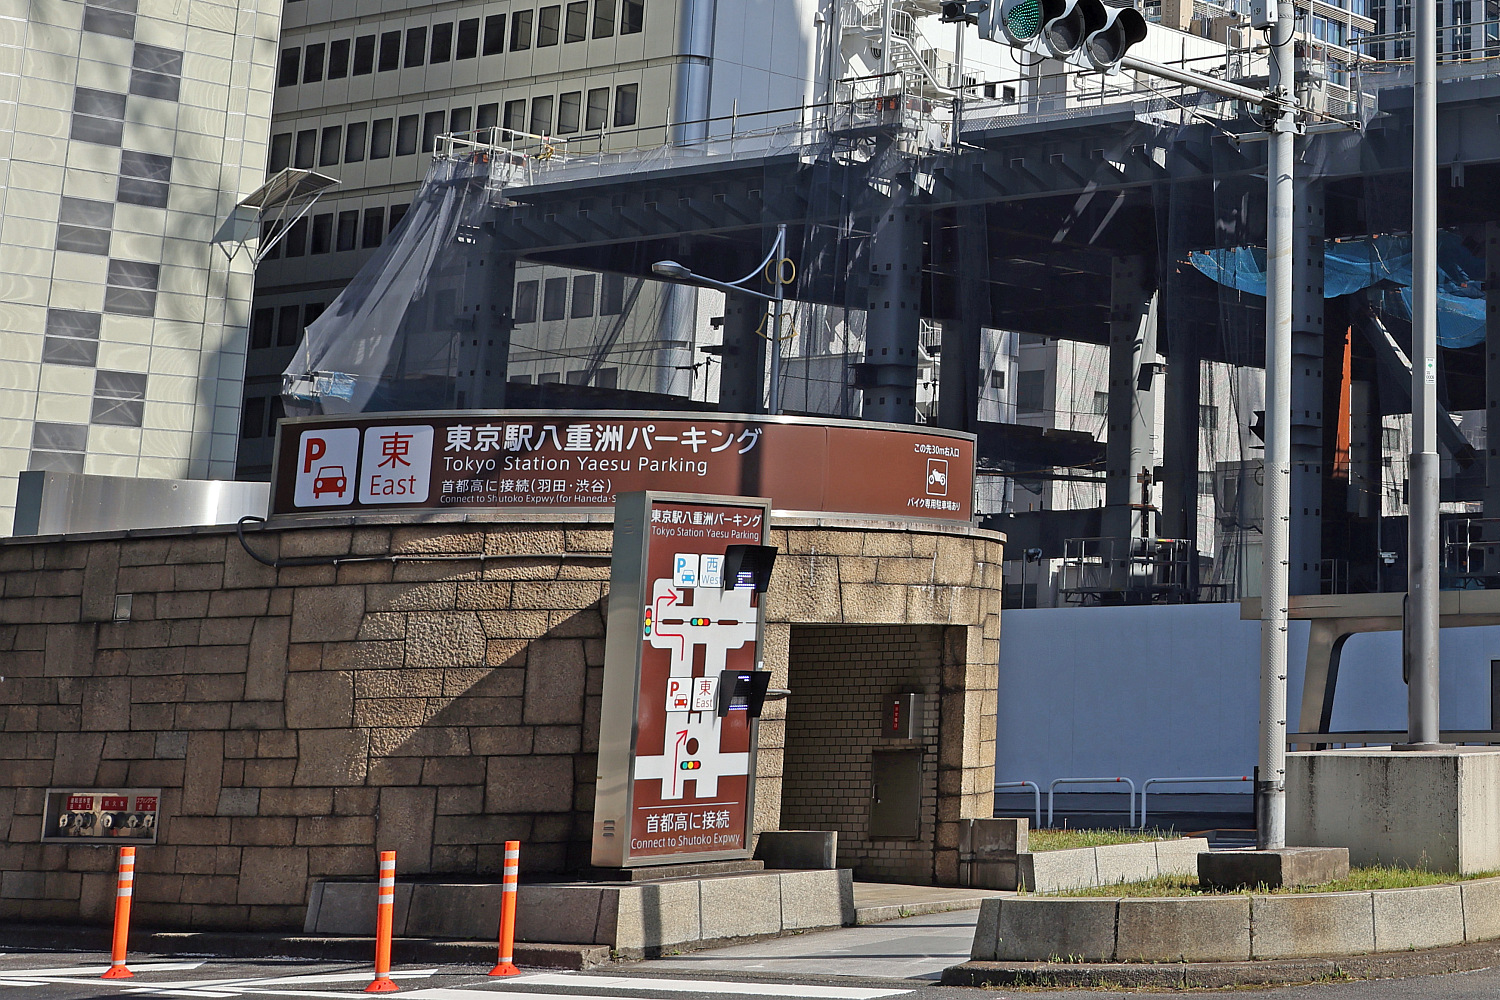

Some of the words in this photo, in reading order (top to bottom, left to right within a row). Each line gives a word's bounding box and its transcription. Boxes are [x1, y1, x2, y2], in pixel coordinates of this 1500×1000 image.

[444, 423, 763, 455] 東京駅八重洲パーキング
[304, 438, 326, 473] P
[377, 431, 414, 469] 東
[914, 444, 960, 457] この先30m右入口
[443, 456, 496, 475] Tokyo
[503, 455, 570, 471] Station
[577, 456, 631, 471] Yaesu
[638, 457, 708, 476] Parking
[370, 474, 417, 496] East
[440, 494, 474, 504] Connect
[476, 495, 485, 503] to
[487, 494, 524, 503] Shutoko
[907, 497, 960, 511] バイク専用駐車場あり
[651, 509, 762, 528] 東京駅八重洲パーキング
[652, 525, 675, 538] Tokyo
[677, 527, 704, 538] Station
[706, 528, 730, 538] Yaesu
[731, 530, 759, 542] Parking
[706, 557, 718, 572] 西
[699, 680, 712, 696] 東
[696, 698, 712, 708] East
[646, 809, 730, 833] 首都高に接続
[631, 838, 666, 850] Connect
[668, 838, 676, 847] to
[678, 834, 712, 846] Shutoko
[714, 833, 742, 846] Expwy.
